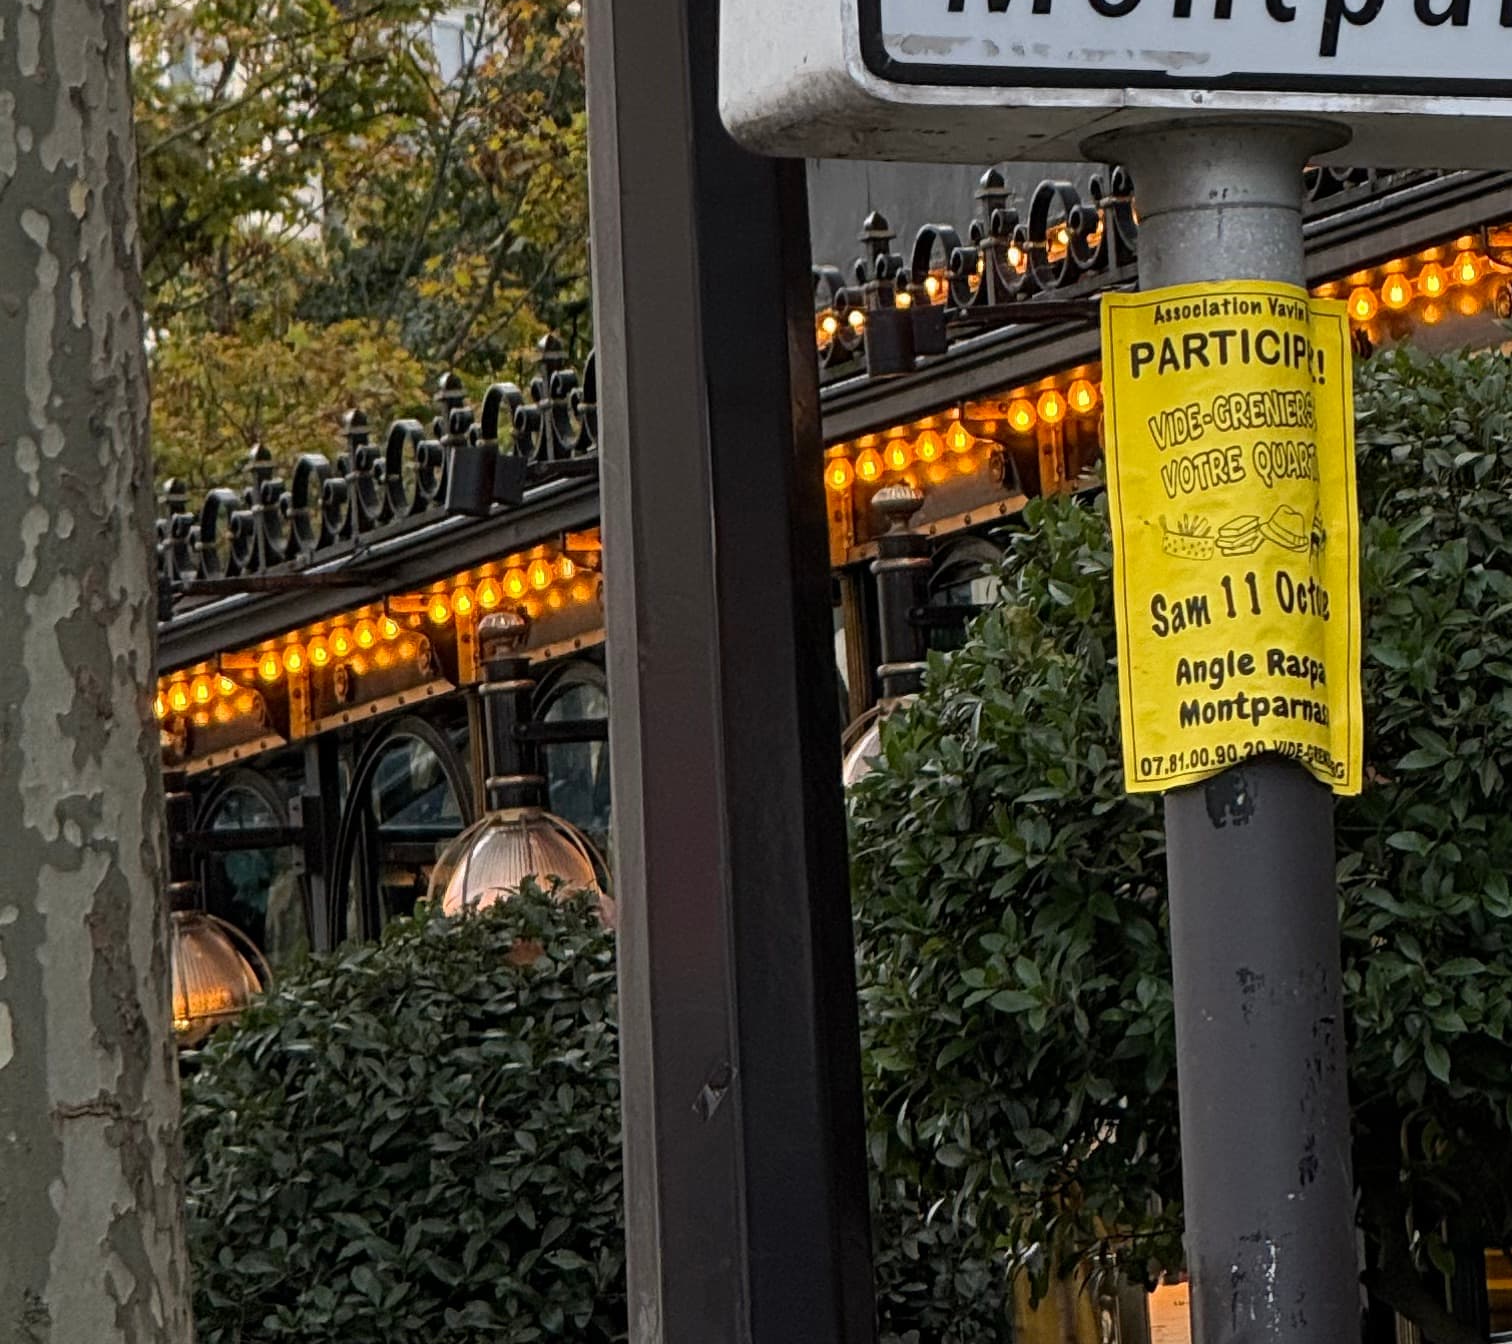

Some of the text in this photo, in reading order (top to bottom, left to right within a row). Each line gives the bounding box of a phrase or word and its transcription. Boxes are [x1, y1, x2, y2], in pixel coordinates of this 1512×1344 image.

[1153, 297, 1262, 325] Association
[1160, 445, 1246, 499] VOTRE
[1150, 593, 1211, 637] Sam
[1220, 570, 1261, 618] 11
[1176, 649, 1256, 690] Angle
[1140, 740, 1265, 776] 07.81.00.90.20
